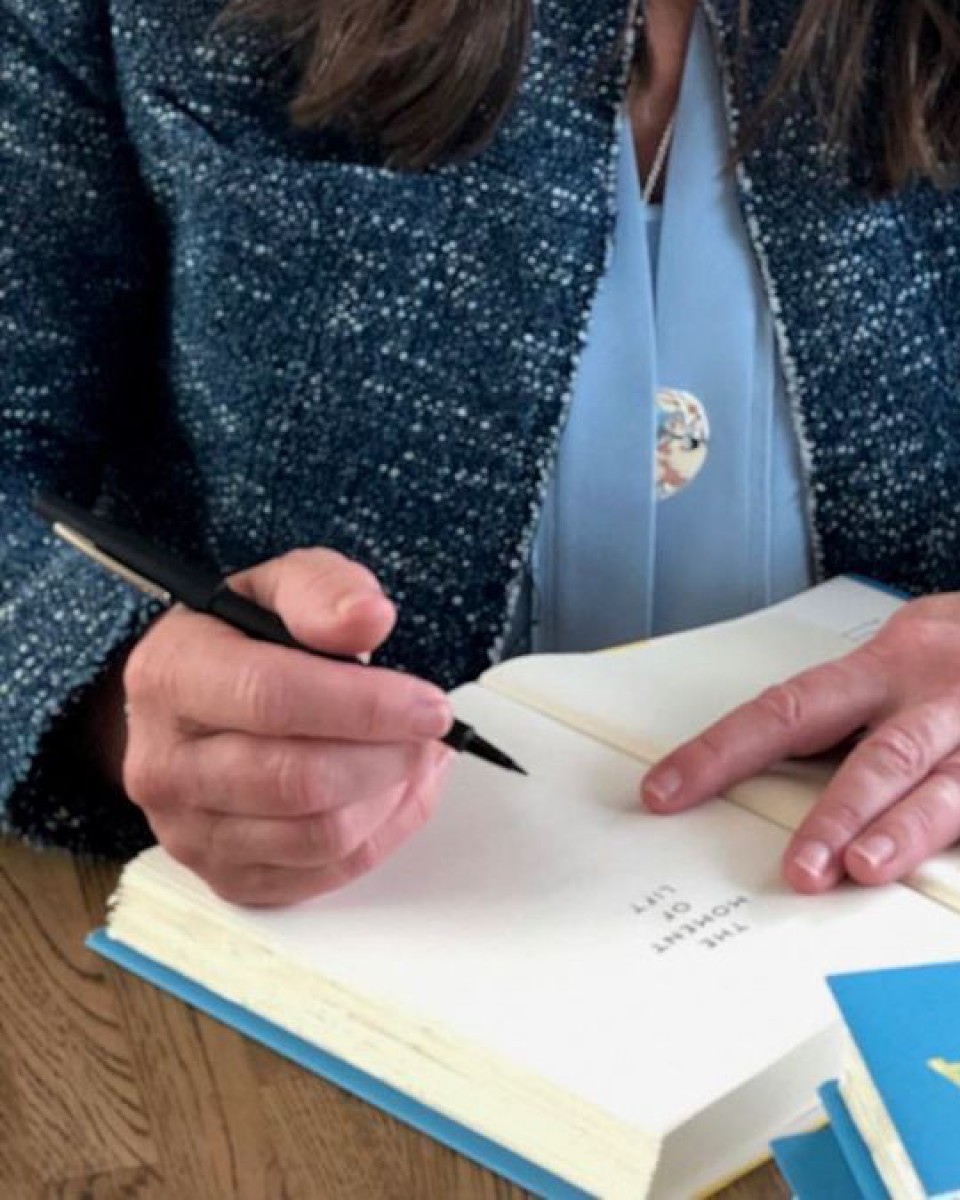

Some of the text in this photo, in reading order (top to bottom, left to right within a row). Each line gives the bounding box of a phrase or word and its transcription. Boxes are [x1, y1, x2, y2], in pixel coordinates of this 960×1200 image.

[629, 885, 676, 914] LIFT
[663, 901, 691, 921] OF
[651, 896, 749, 953] MOMENT
[698, 921, 750, 949] THE
